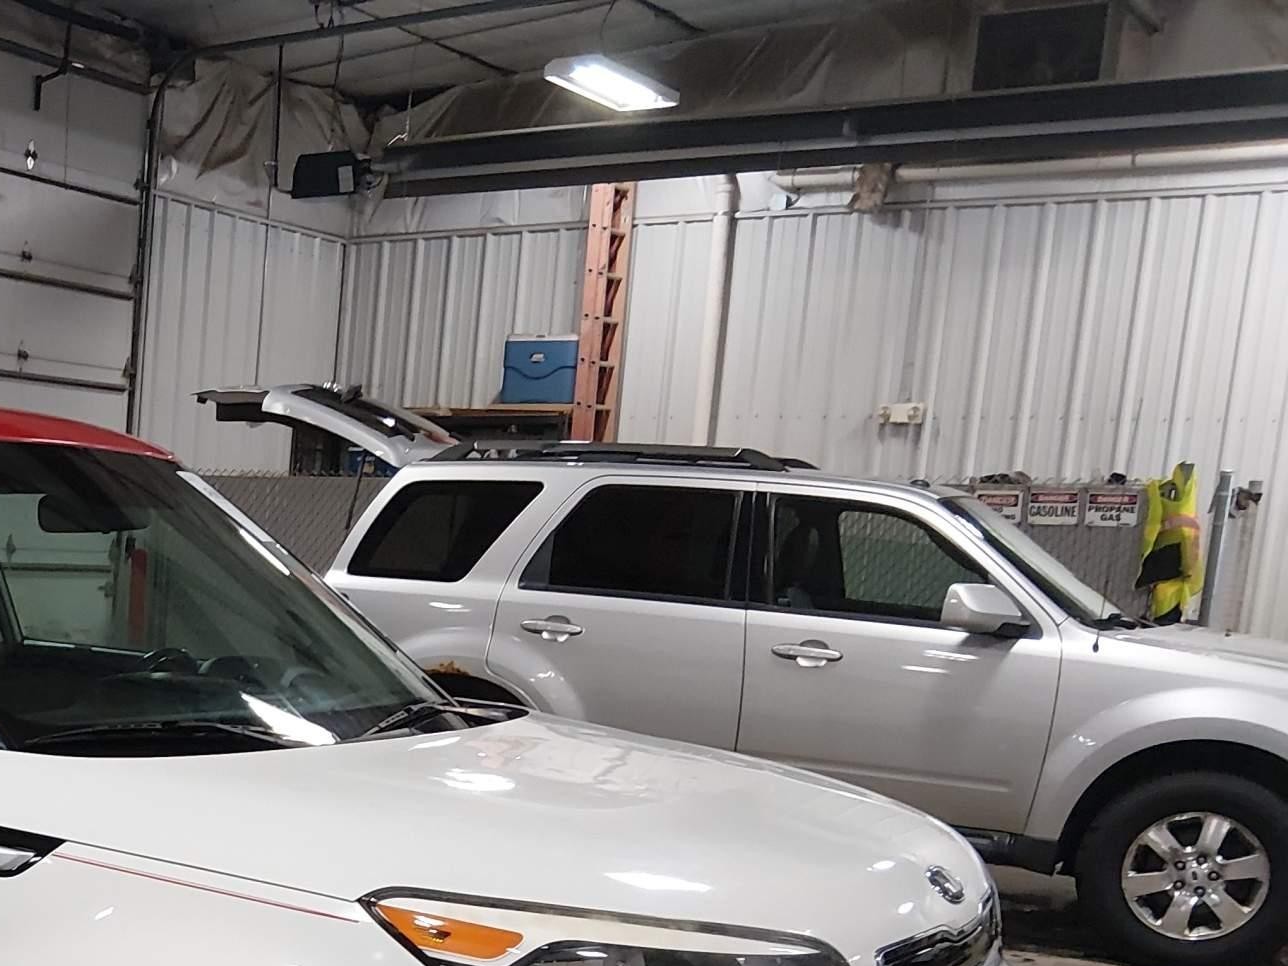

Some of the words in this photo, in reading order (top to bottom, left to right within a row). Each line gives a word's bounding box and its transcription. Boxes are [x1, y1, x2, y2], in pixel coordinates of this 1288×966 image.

[1029, 505, 1077, 518] GASOLINE
[1088, 505, 1136, 514] PROPANE
[1100, 513, 1121, 522] GAS
